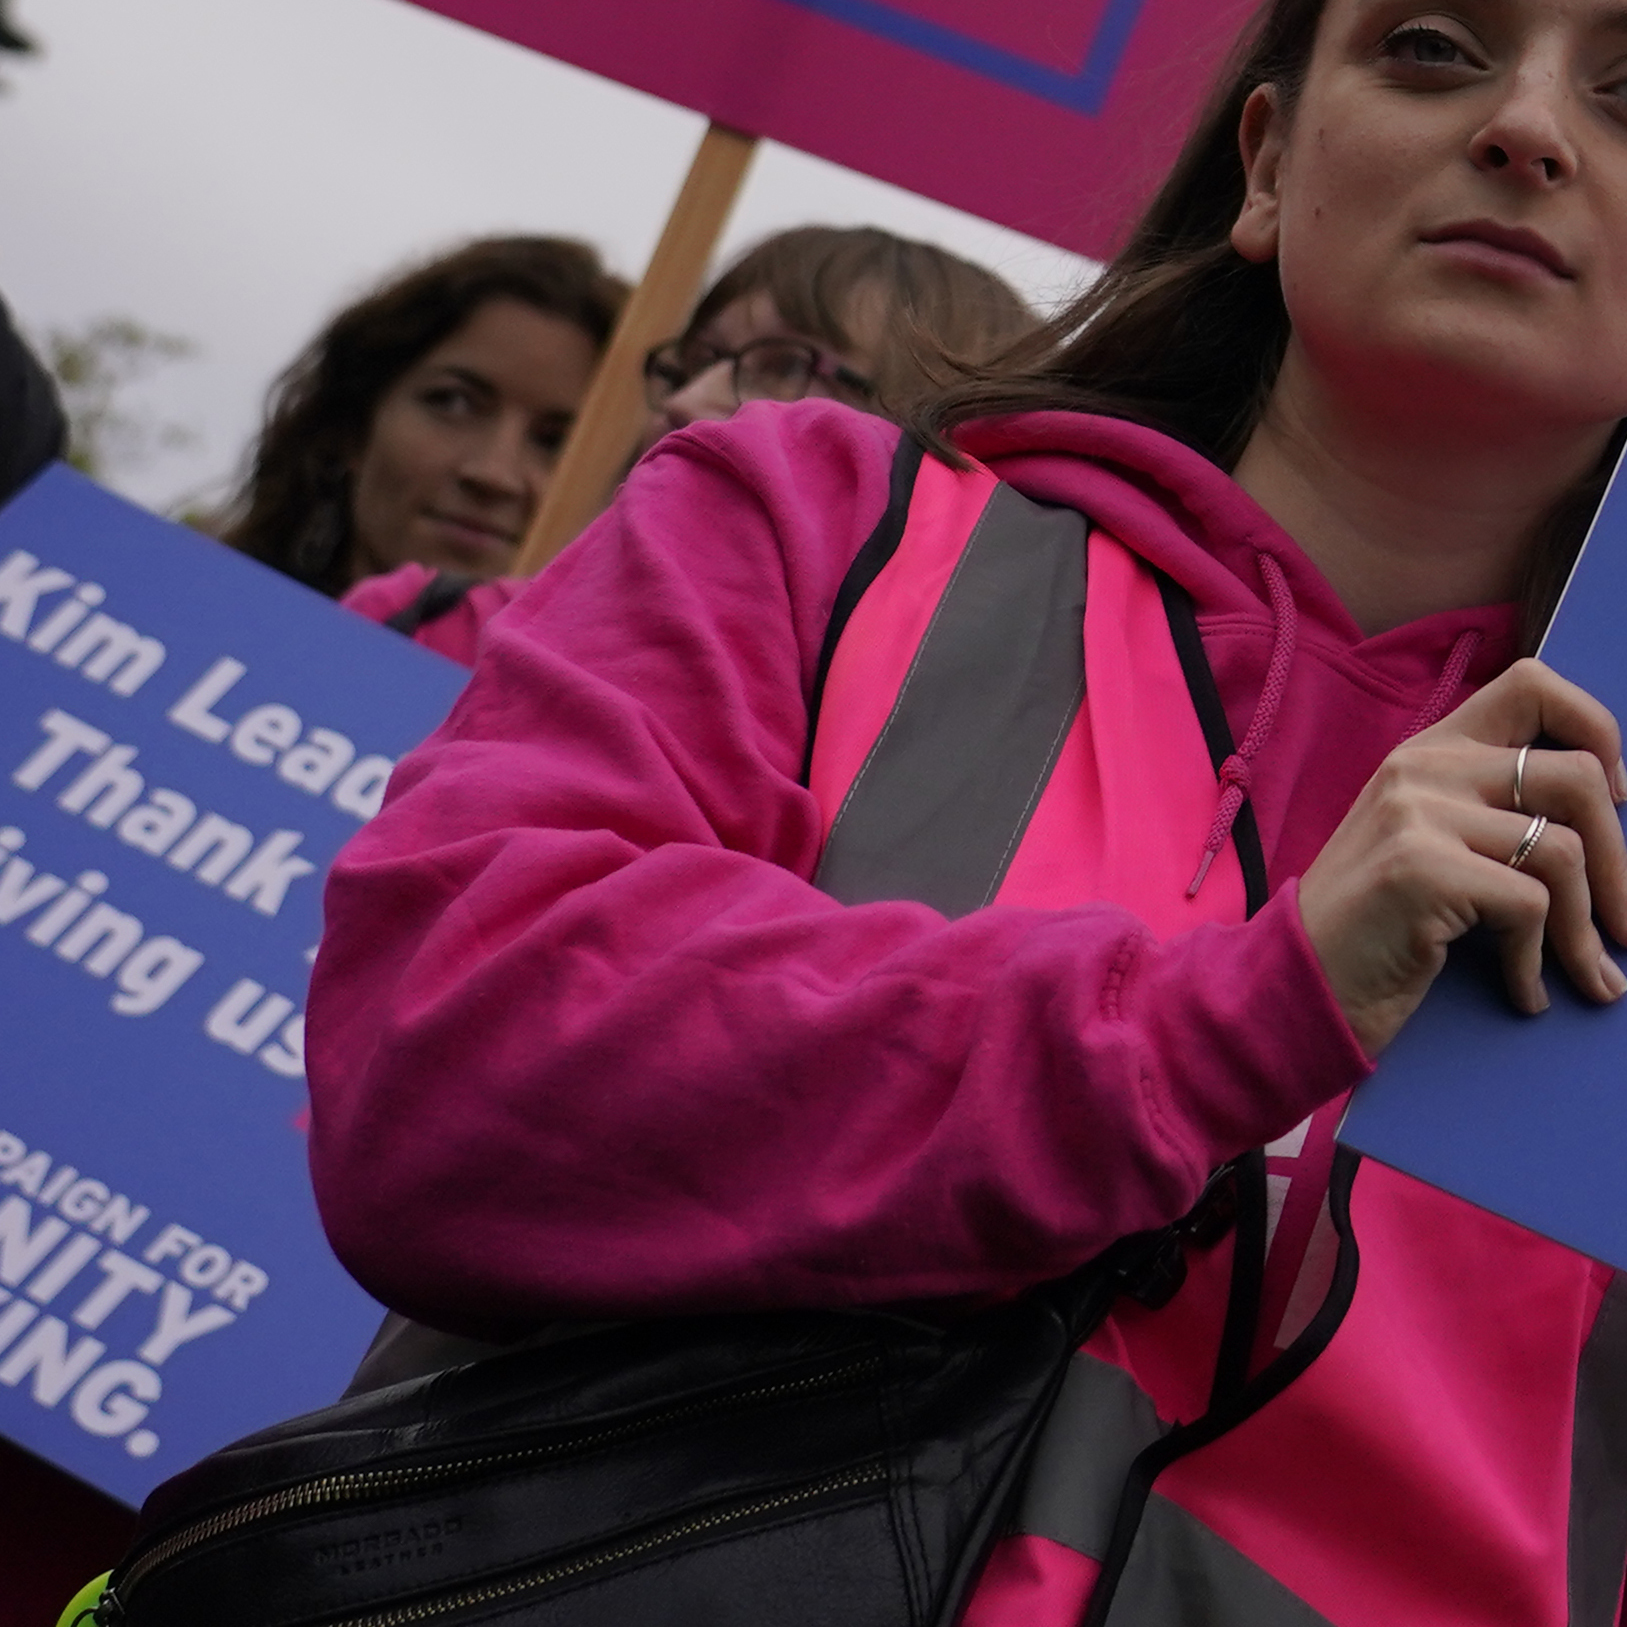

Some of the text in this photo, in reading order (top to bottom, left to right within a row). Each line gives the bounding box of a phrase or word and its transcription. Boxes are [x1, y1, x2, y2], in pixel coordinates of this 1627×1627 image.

[0, 549, 167, 699] Kim
[13, 709, 317, 918] Thank
[143, 1223, 270, 1312] FOR
[0, 1286, 162, 1458] ING.
